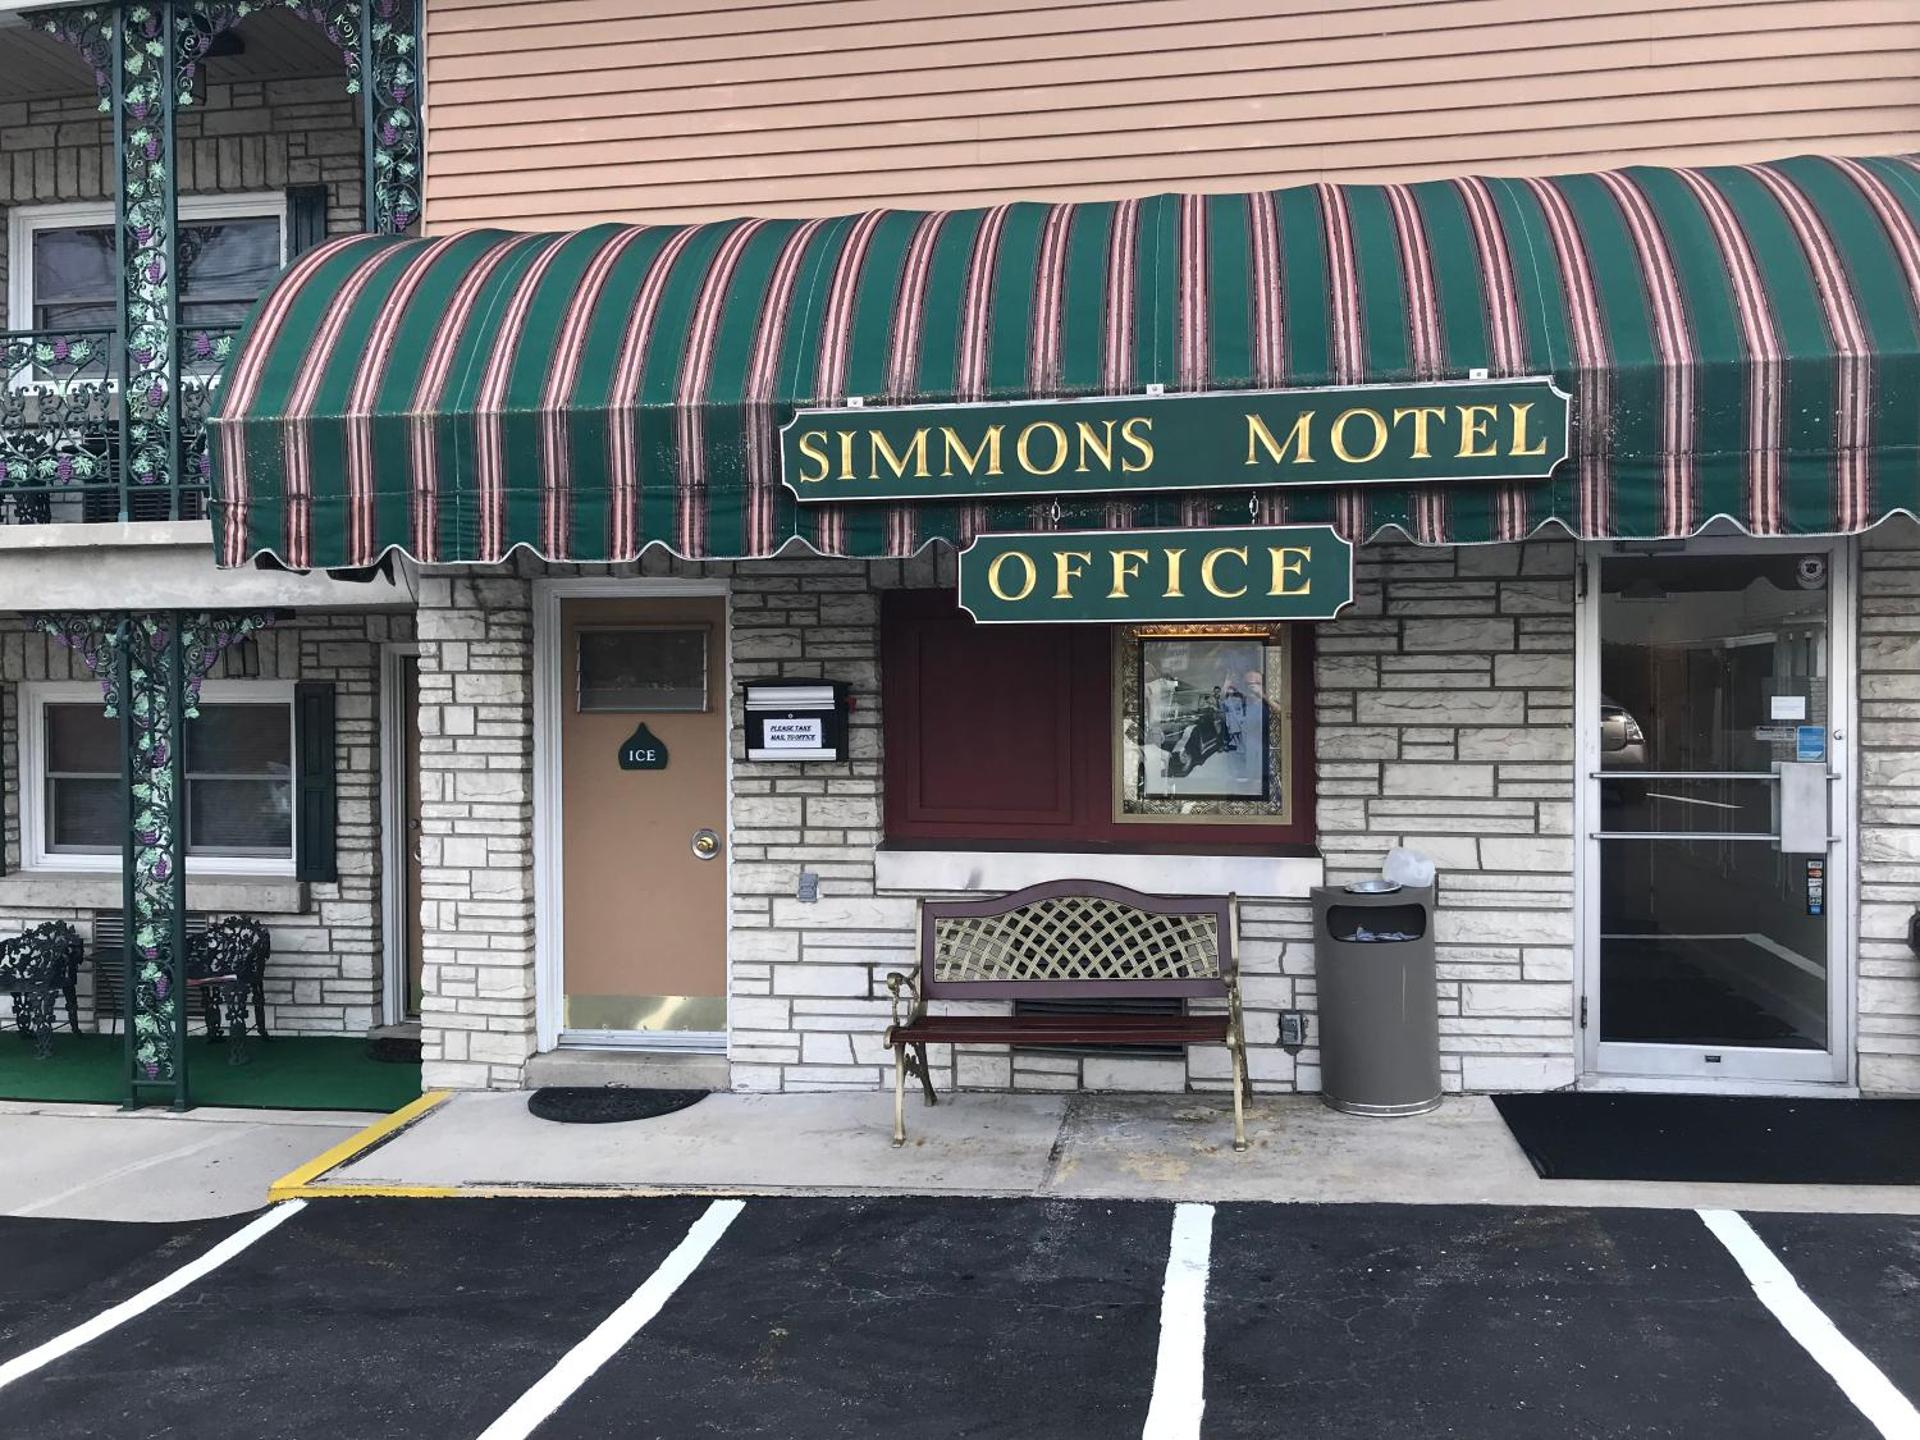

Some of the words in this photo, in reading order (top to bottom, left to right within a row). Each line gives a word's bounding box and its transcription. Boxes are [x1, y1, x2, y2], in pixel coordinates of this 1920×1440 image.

[798, 418, 1155, 482] SIMMONS
[1247, 403, 1548, 465] MOTEL
[987, 546, 1313, 601] OFFICE
[629, 749, 656, 761] ICE
